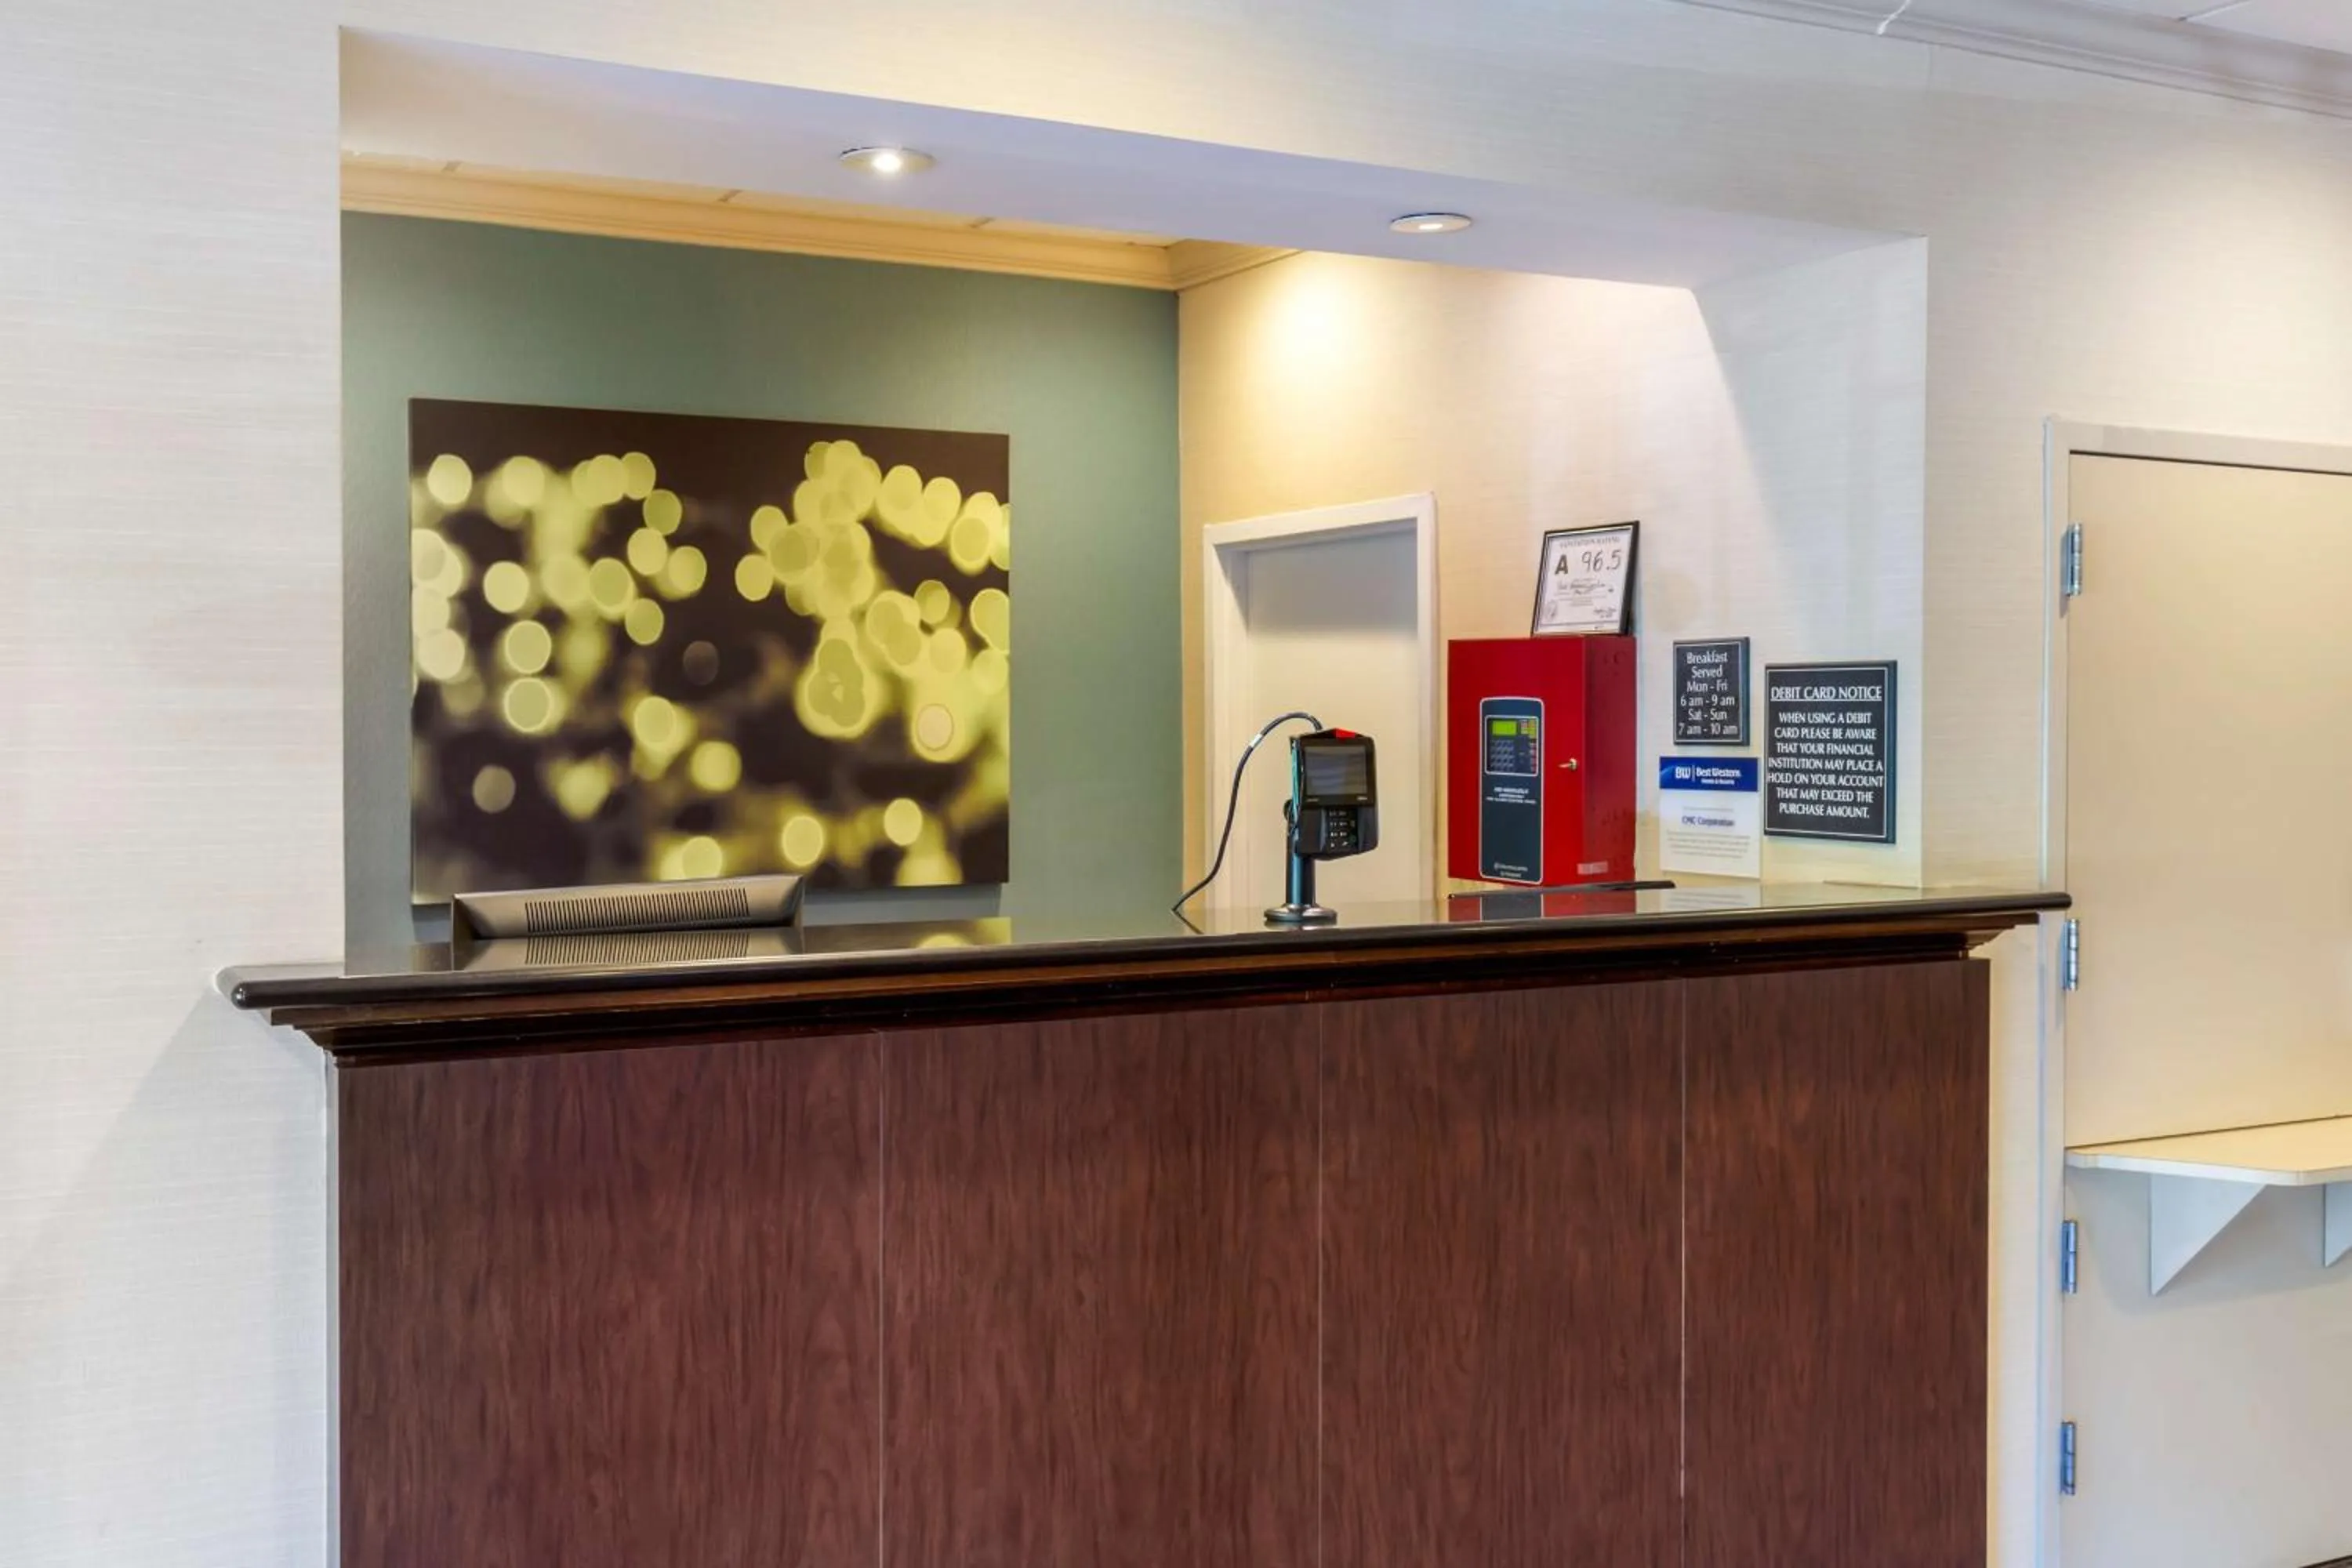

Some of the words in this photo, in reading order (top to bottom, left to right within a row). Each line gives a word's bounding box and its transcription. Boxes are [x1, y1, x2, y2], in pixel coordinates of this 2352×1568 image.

[1555, 554, 1569, 575] A
[1581, 549, 1621, 573] 96.5
[1686, 650, 1728, 664] Breakfast
[1691, 664, 1723, 678] Served
[1686, 681, 1708, 692] Mon
[1716, 679, 1728, 691] Fri
[1771, 686, 1801, 699] DEBIT
[1803, 686, 1836, 699] CARD
[1838, 685, 1882, 699] NOTICE
[1680, 695, 1686, 706] 6
[1688, 697, 1704, 706] am
[1711, 694, 1718, 706] 9
[1719, 696, 1735, 706] am
[1688, 708, 1702, 720] Sat
[1710, 708, 1727, 720] Sun
[1778, 712, 1806, 723] WHEN
[1807, 712, 1835, 724] USING
[1837, 713, 1844, 724] A
[1846, 712, 1872, 724] DEBIT
[1679, 723, 1685, 735] 7
[1686, 725, 1702, 735] am
[1710, 723, 1721, 735] 10
[1722, 725, 1738, 735] am
[1774, 728, 1799, 739] CARD
[1801, 728, 1830, 739] PLEASE
[1832, 728, 1843, 739] BE
[1845, 728, 1877, 739] AWARE
[1777, 742, 1798, 753] THAT
[1799, 743, 1824, 754] YOUR
[1826, 743, 1875, 755] FINANCIAL
[1768, 757, 1823, 770] INSTITUTION
[1824, 759, 1845, 771] MAY
[1846, 760, 1874, 771] PLACE
[1875, 760, 1883, 771] A
[1675, 766, 1691, 779] BW
[1696, 766, 1711, 777] Best
[1767, 772, 1792, 784] HOLD
[1794, 773, 1809, 784] ON
[1810, 774, 1835, 785] YOUR
[1837, 775, 1884, 787] ACCOUNT
[1776, 787, 1798, 799] THAT
[1800, 789, 1820, 800] MAY
[1821, 789, 1853, 802] EXCEED
[1856, 791, 1874, 803] THE
[1779, 802, 1824, 816] PURCHASE
[1826, 806, 1870, 818] AMOUNT.
